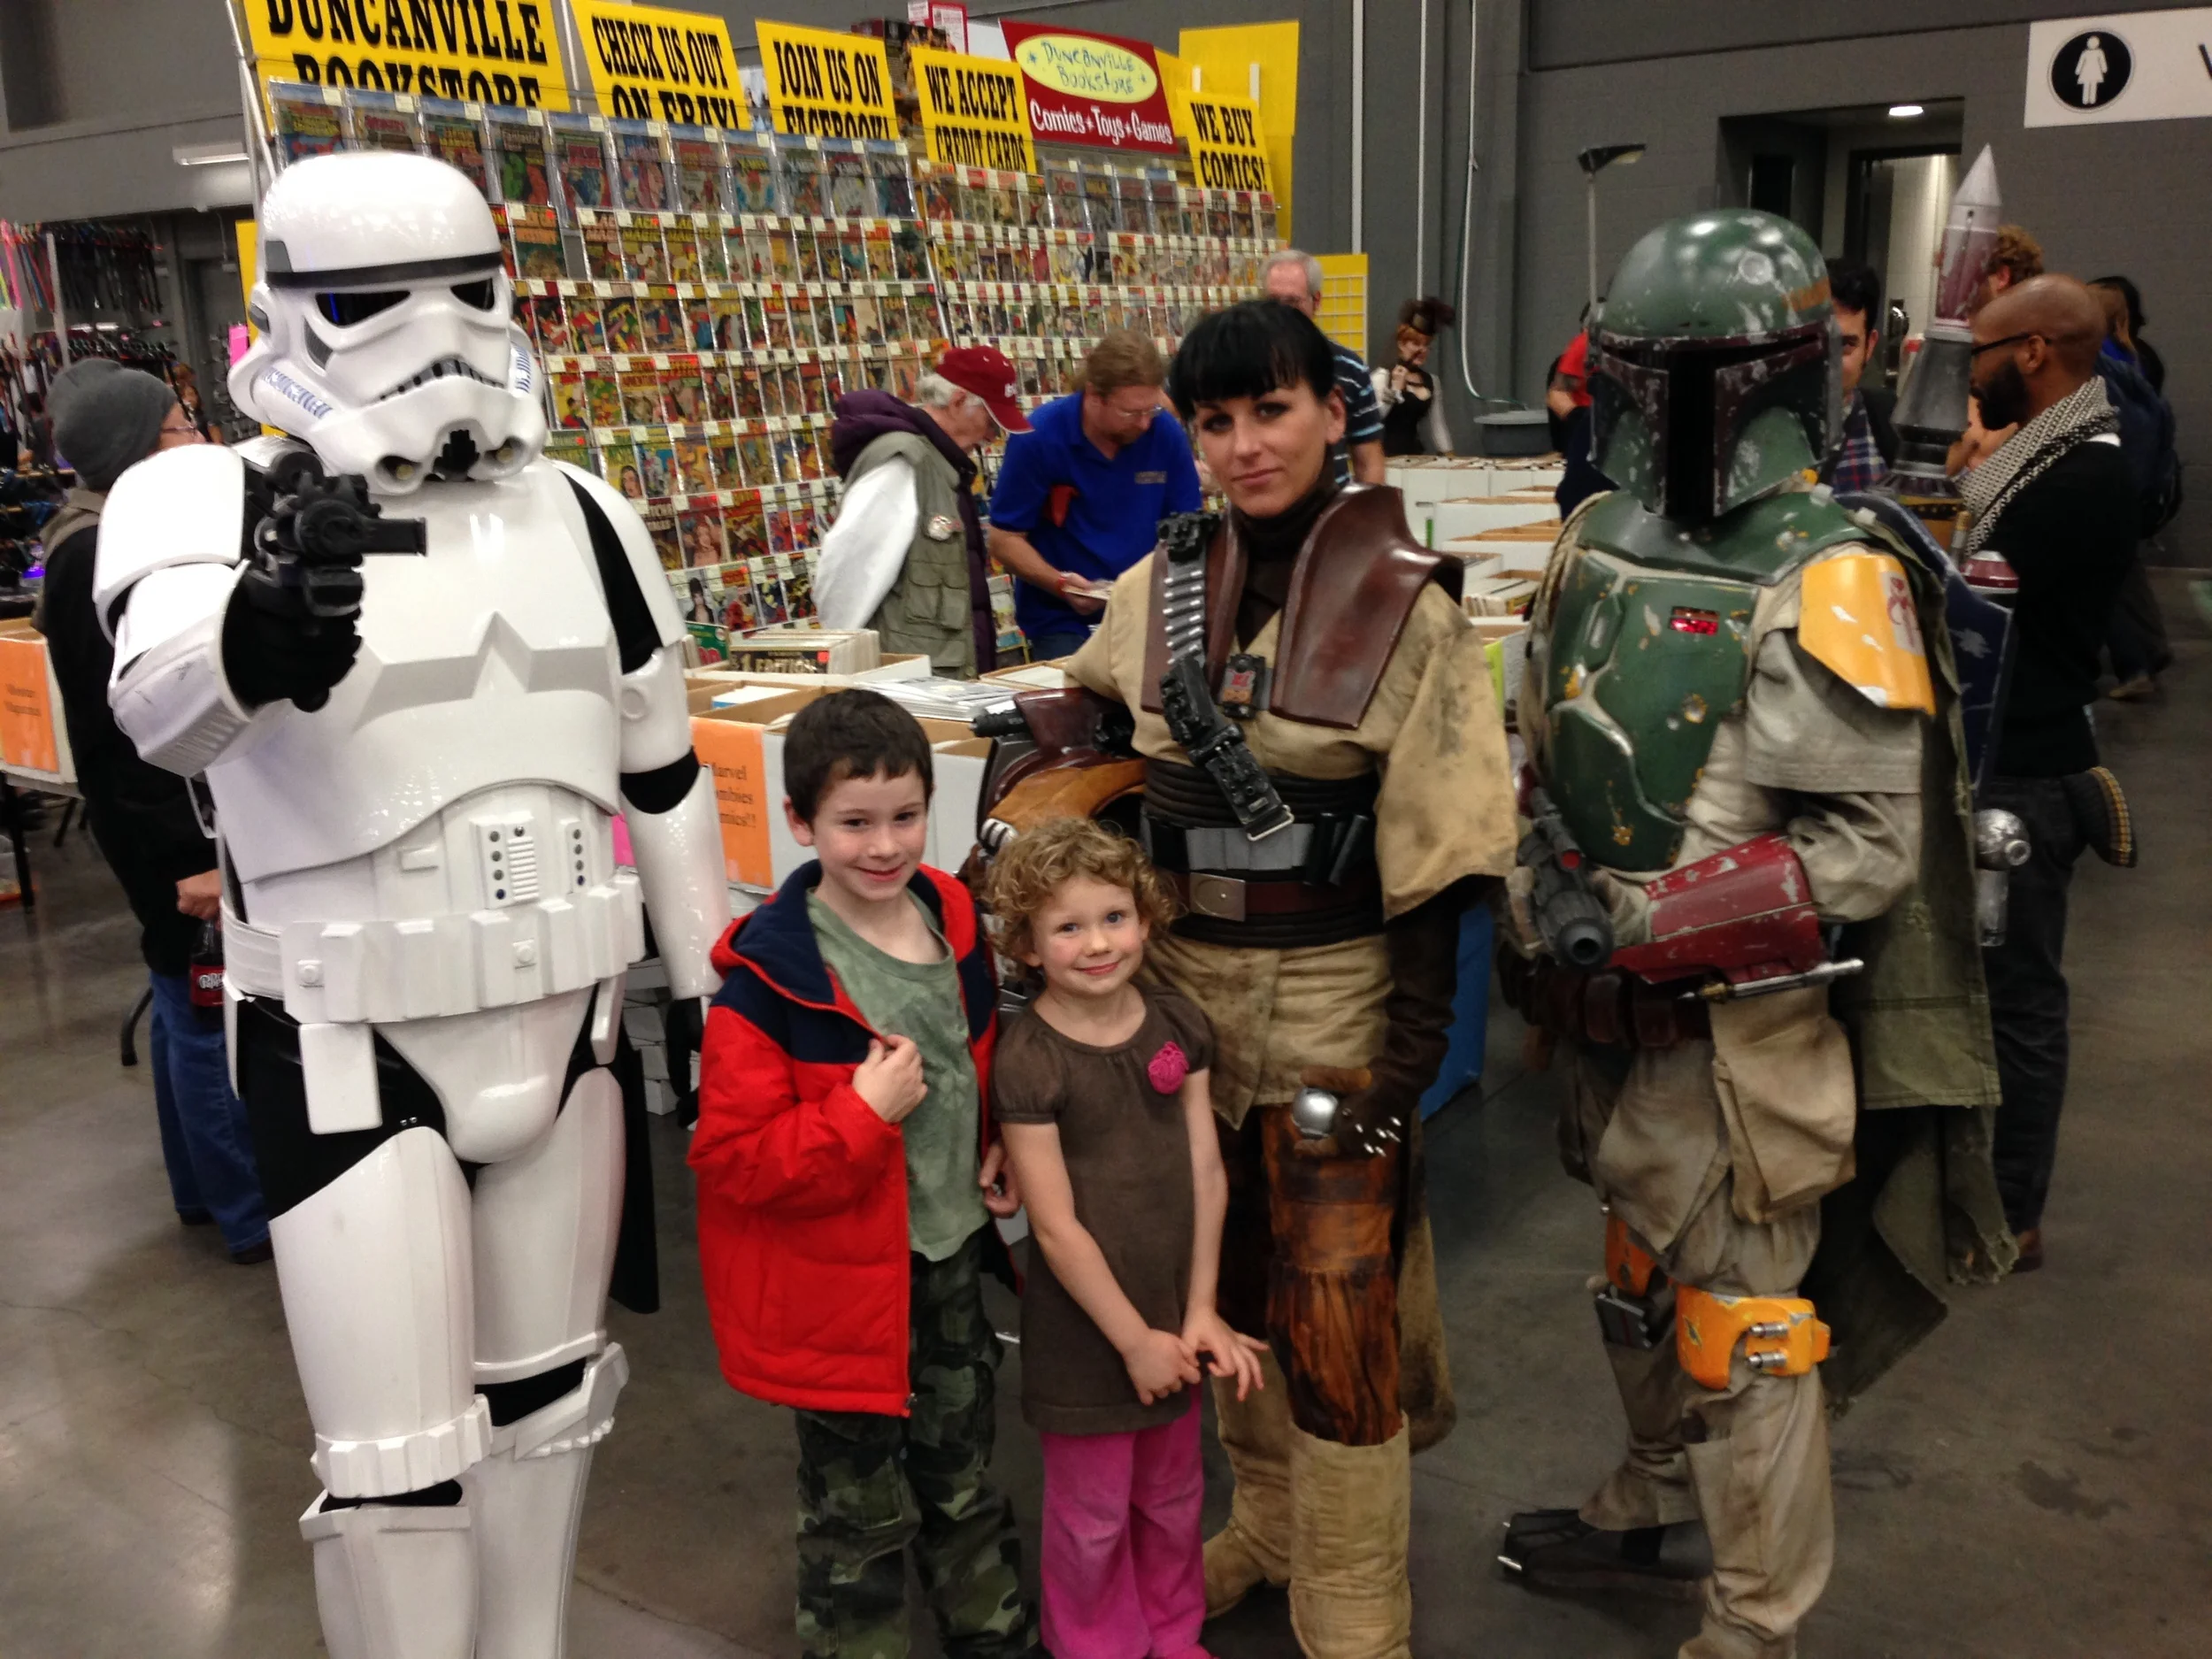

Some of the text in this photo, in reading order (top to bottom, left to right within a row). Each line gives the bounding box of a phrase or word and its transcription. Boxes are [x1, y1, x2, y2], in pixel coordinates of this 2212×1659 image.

[266, 0, 548, 65] DUNCANVILLE
[591, 15, 730, 90] CHECK US OUT
[772, 40, 884, 108] JOIN US ON
[925, 65, 1019, 124] WE ACCEPT
[611, 84, 653, 119] ON
[1029, 97, 1175, 147] Comics Toys Games
[1190, 102, 1256, 149] WE BUY
[935, 125, 985, 168] CREDIT
[986, 130, 1028, 173] CARDS
[1200, 150, 1269, 191] COMICS!
